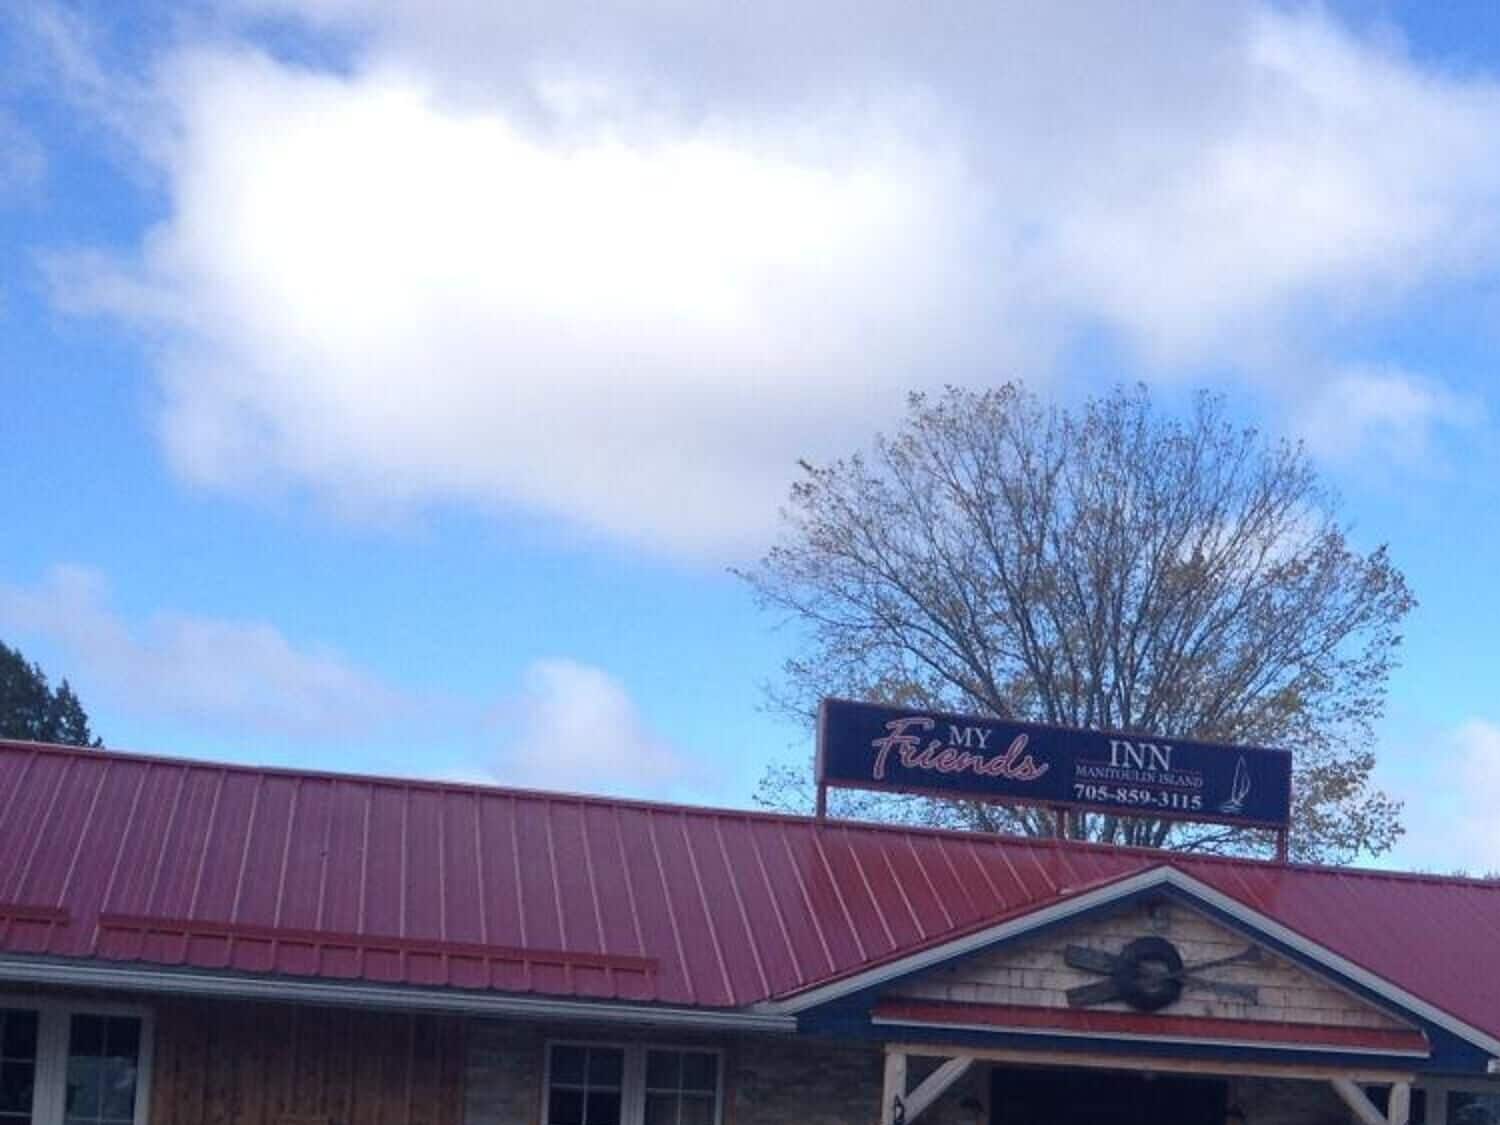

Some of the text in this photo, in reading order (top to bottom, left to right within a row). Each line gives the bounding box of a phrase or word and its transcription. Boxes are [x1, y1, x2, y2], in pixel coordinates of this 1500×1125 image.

[871, 716, 1049, 781] Friends
[949, 725, 992, 749] MY
[1109, 739, 1173, 772] INN
[1075, 765, 1203, 788] MANITOULIN ISLAND
[1073, 783, 1203, 810] 705-859-3115
